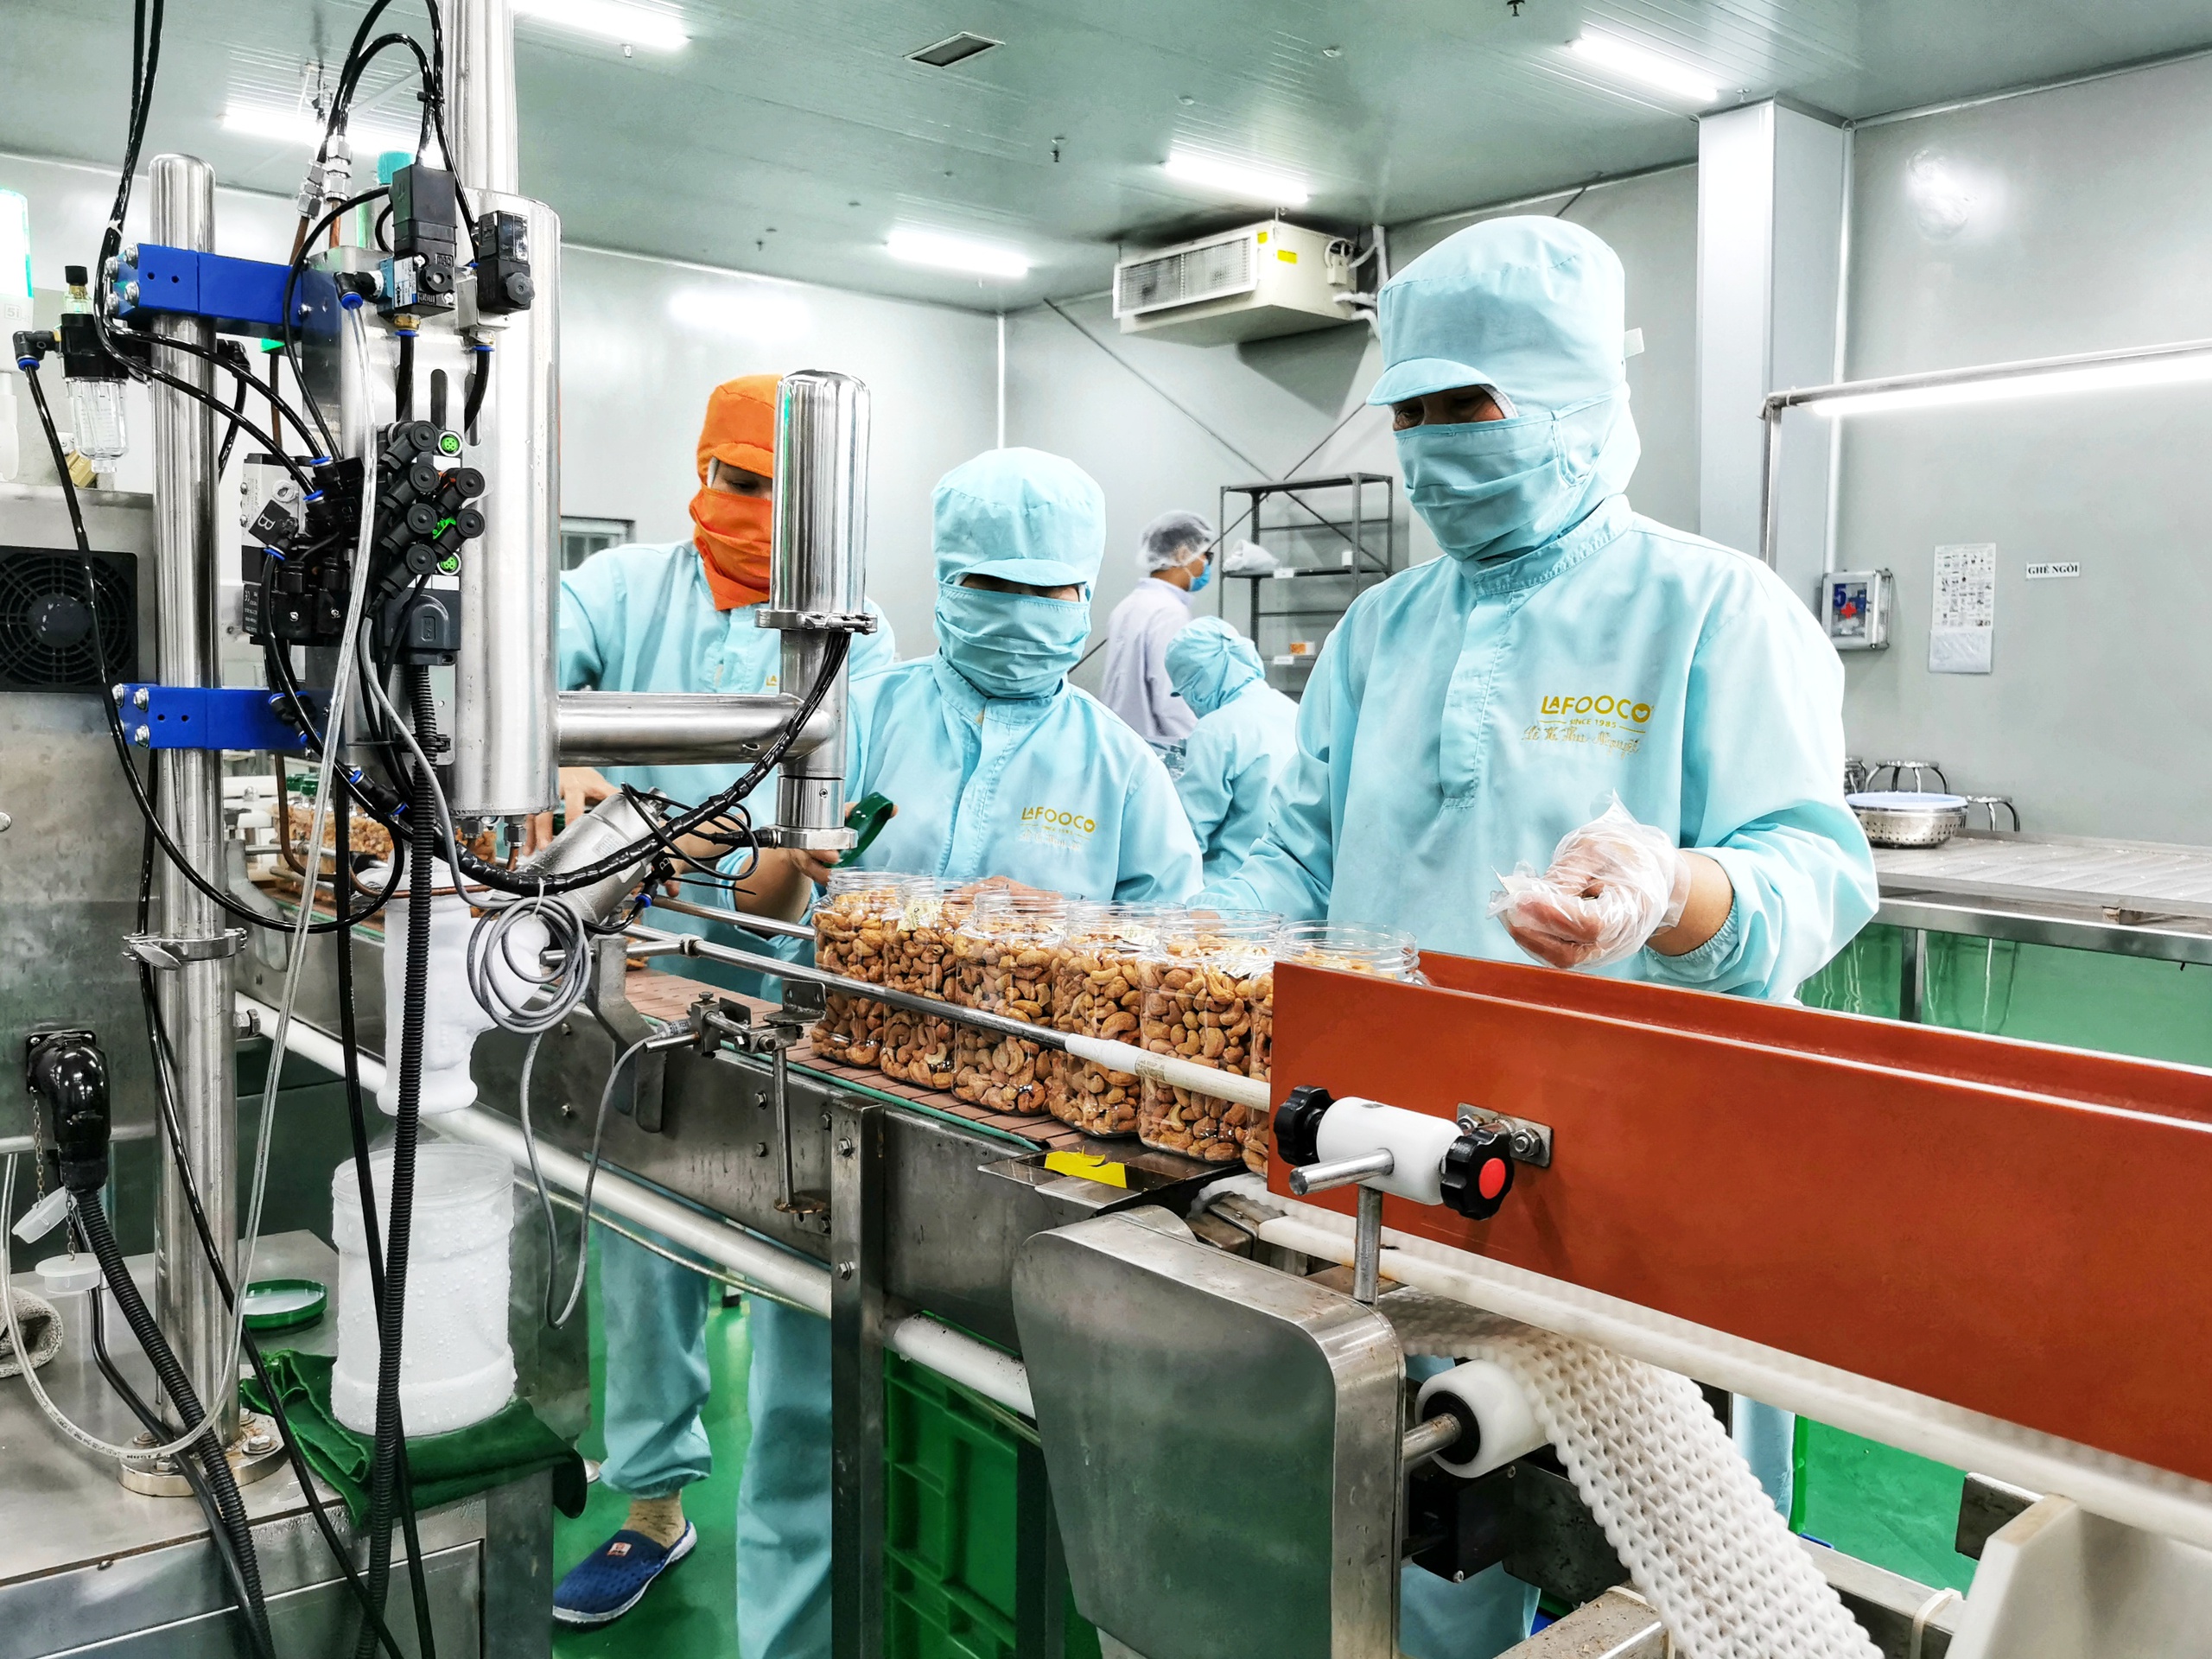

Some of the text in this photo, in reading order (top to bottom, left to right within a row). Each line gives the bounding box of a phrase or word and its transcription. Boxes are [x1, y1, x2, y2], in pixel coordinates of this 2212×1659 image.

[257, 513, 276, 531] B
[1541, 695, 1651, 723] LAFOOCO
[1594, 719, 1617, 728] 1985
[1021, 806, 1096, 833] LAFOOCO
[658, 857, 671, 871] B
